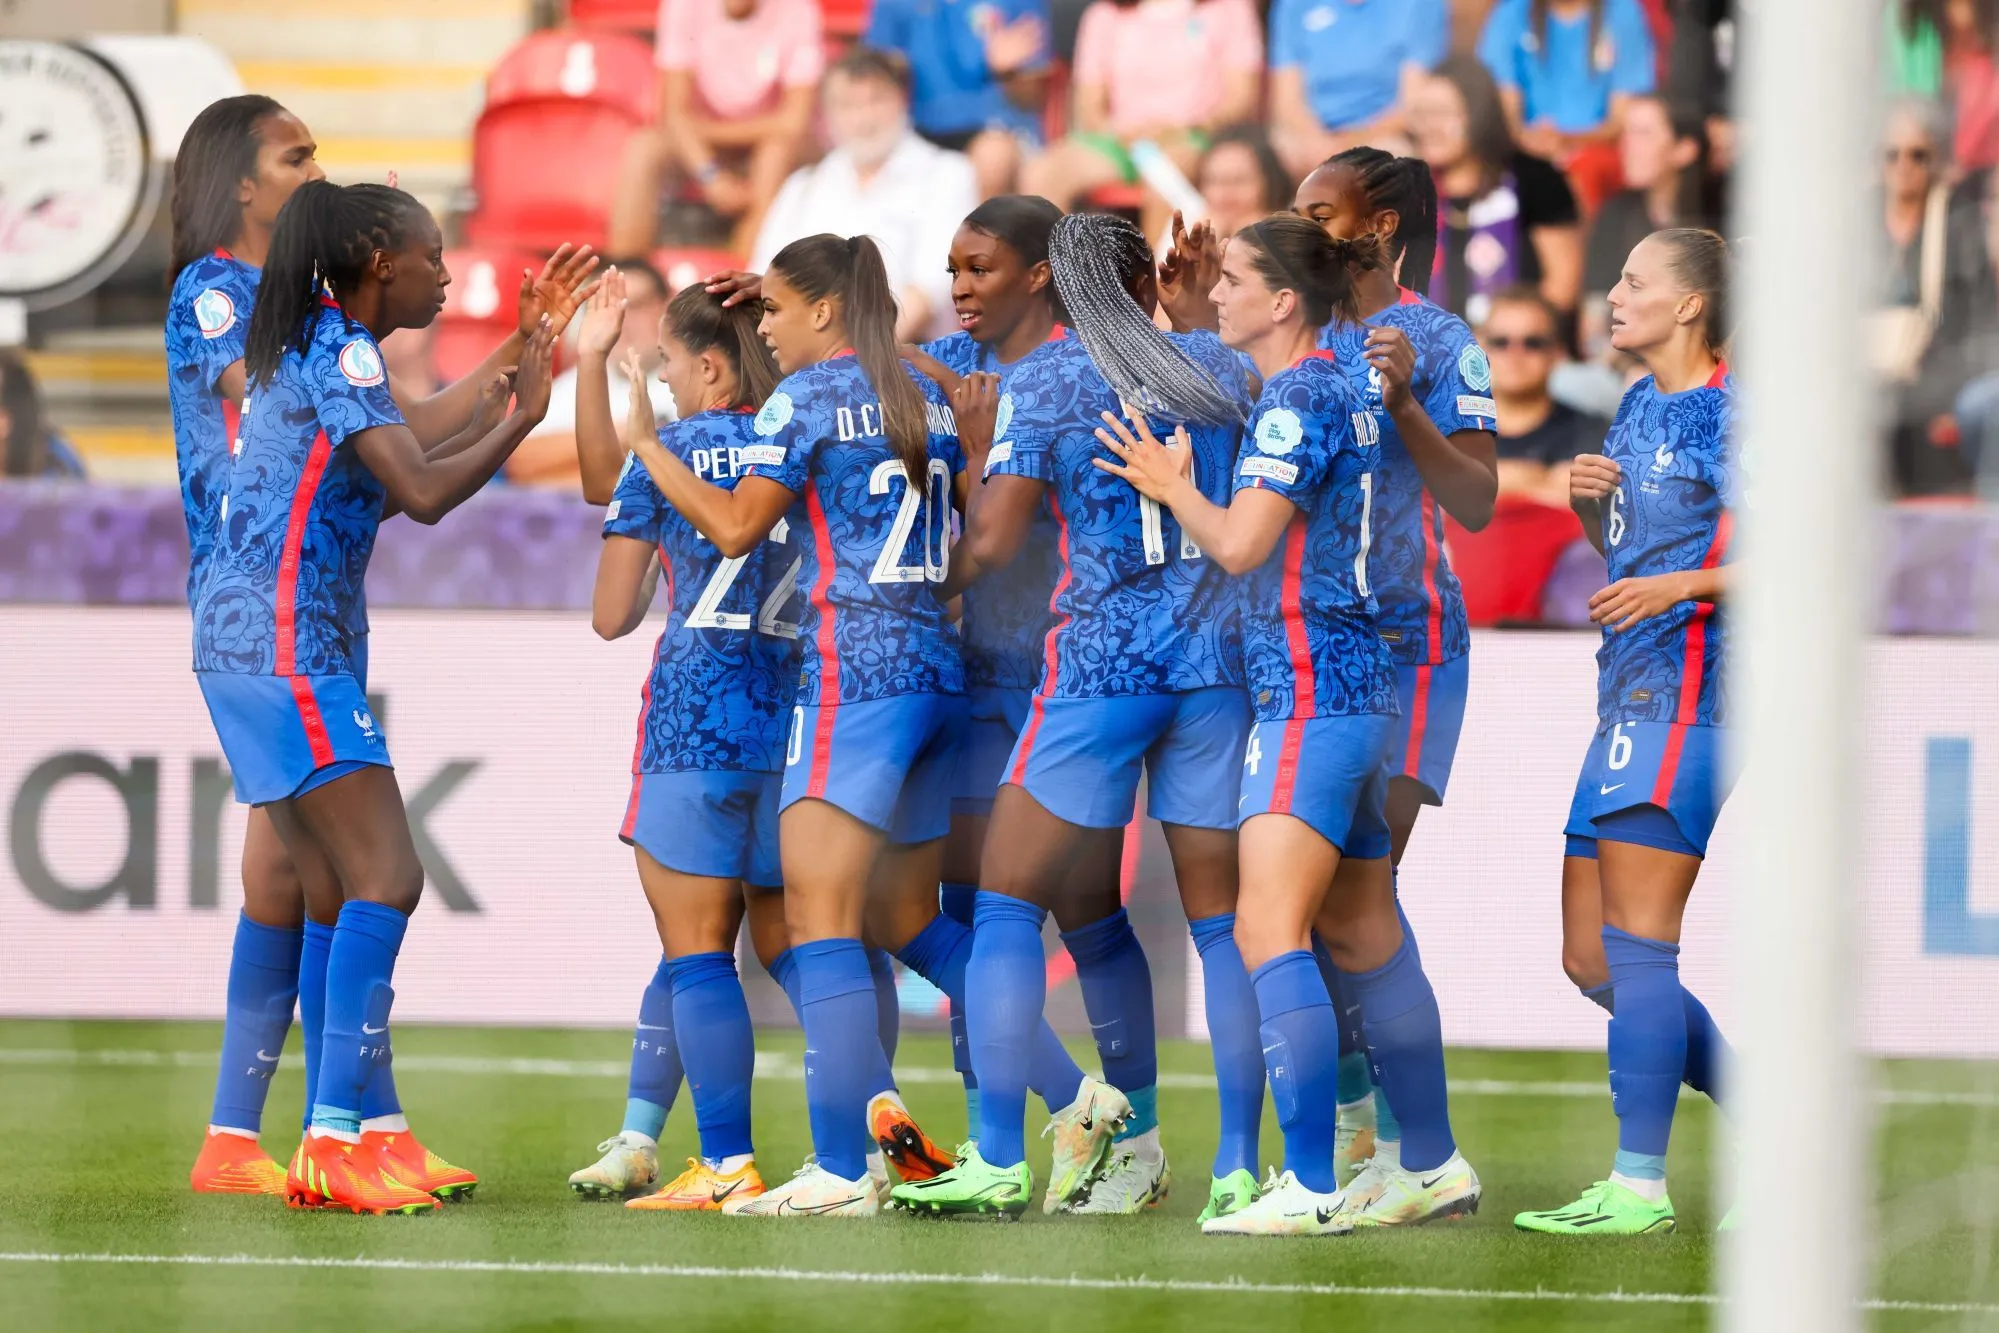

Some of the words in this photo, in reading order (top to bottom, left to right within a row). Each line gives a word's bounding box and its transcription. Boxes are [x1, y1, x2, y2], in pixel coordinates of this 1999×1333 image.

[868, 458, 951, 584] 20
[1608, 486, 1626, 547] 6
[1608, 721, 1637, 770] 6
